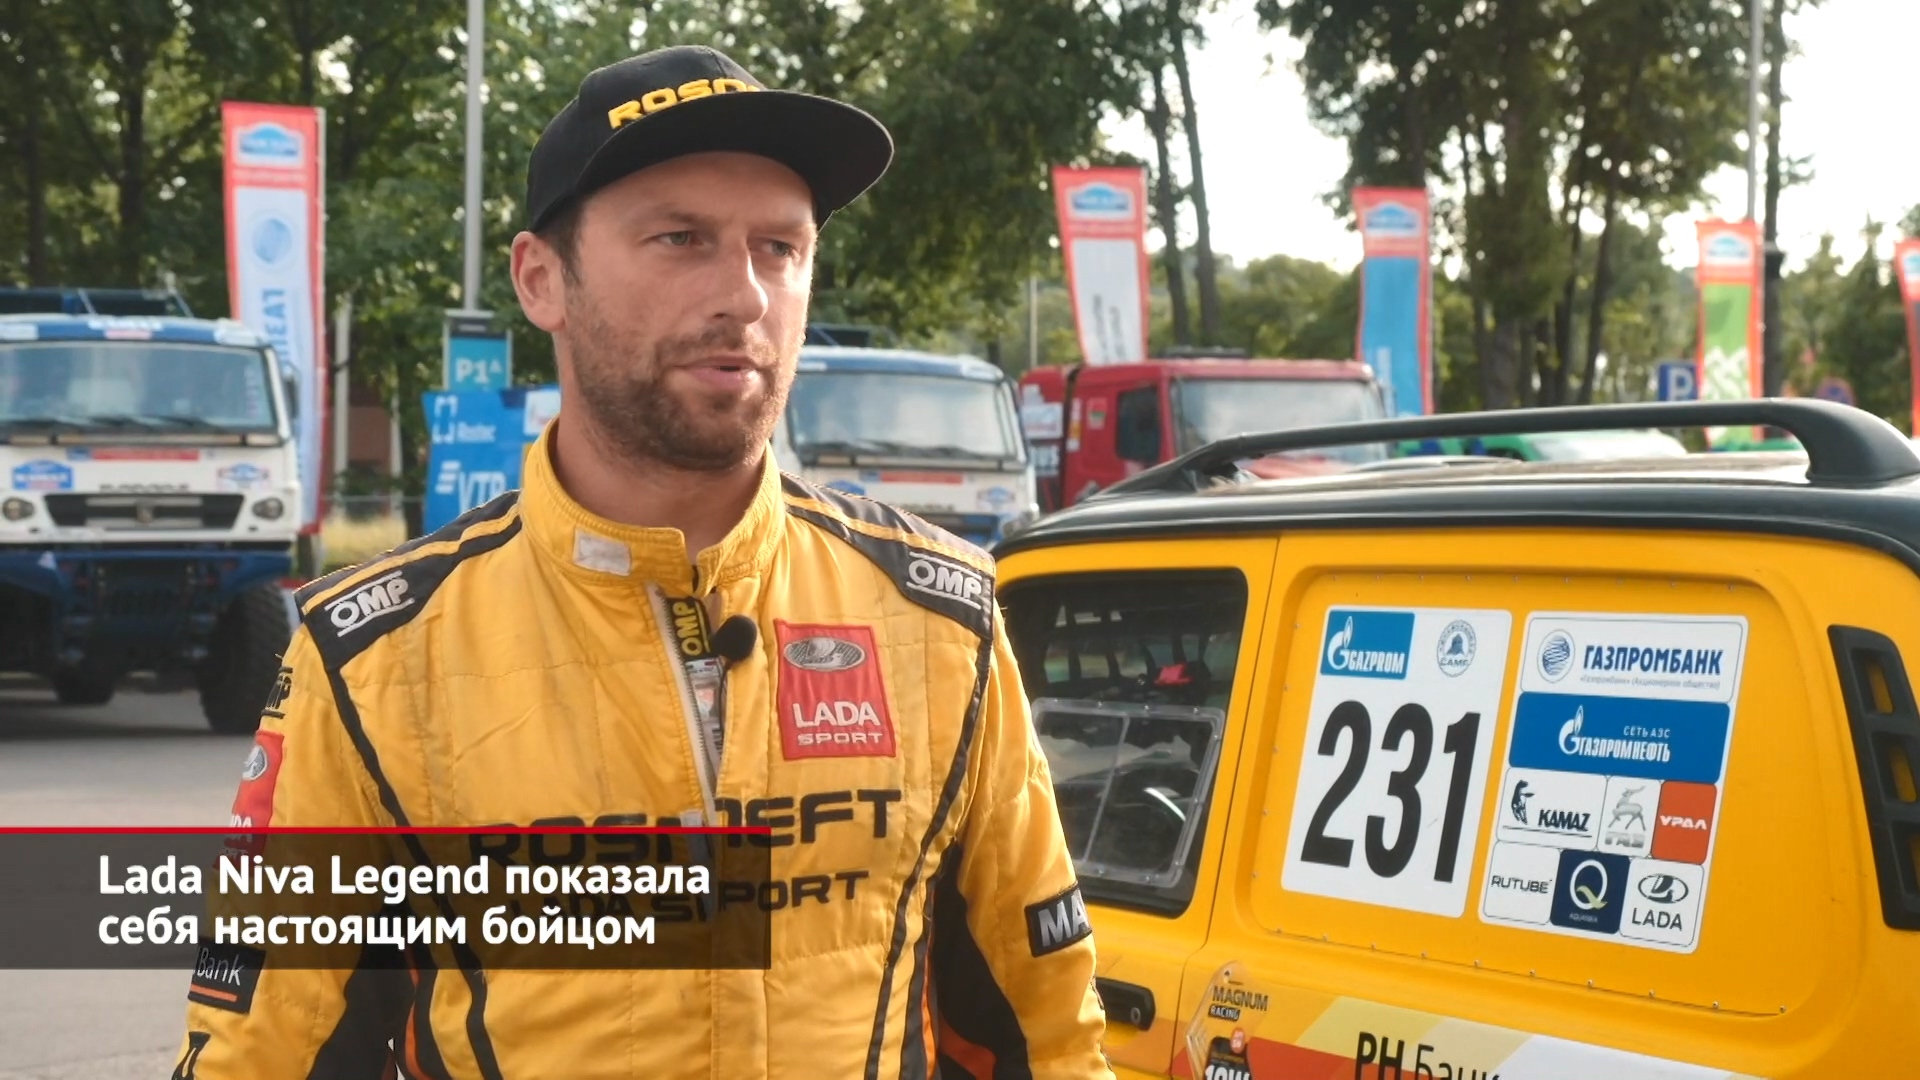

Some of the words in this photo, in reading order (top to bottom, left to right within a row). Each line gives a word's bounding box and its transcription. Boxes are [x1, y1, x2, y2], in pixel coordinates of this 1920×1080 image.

[905, 559, 982, 603] OMP
[330, 578, 410, 629] OMP
[672, 601, 702, 657] OMP
[1349, 650, 1406, 674] GAZPROM
[1582, 644, 1724, 676] ГАЗПРОМБАНК
[792, 700, 881, 728] LADA
[796, 732, 884, 746] SPORT
[1623, 725, 1649, 737] СЕТЬ
[1650, 727, 1671, 739] АЗС
[1578, 736, 1671, 763] ГАЗПРОМНЕФТЬ
[1300, 699, 1482, 884] 231
[1538, 808, 1592, 832] KAMAZ
[1659, 814, 1708, 831] УРАЛ
[1490, 874, 1551, 895] RUTUBE
[1631, 907, 1683, 932] LADA
[196, 946, 244, 986] Bank
[1212, 985, 1269, 1012] MAGNUM
[1209, 1005, 1240, 1020] RACING
[1354, 1031, 1405, 1080] РН
[1414, 1043, 1500, 1080] Ба
